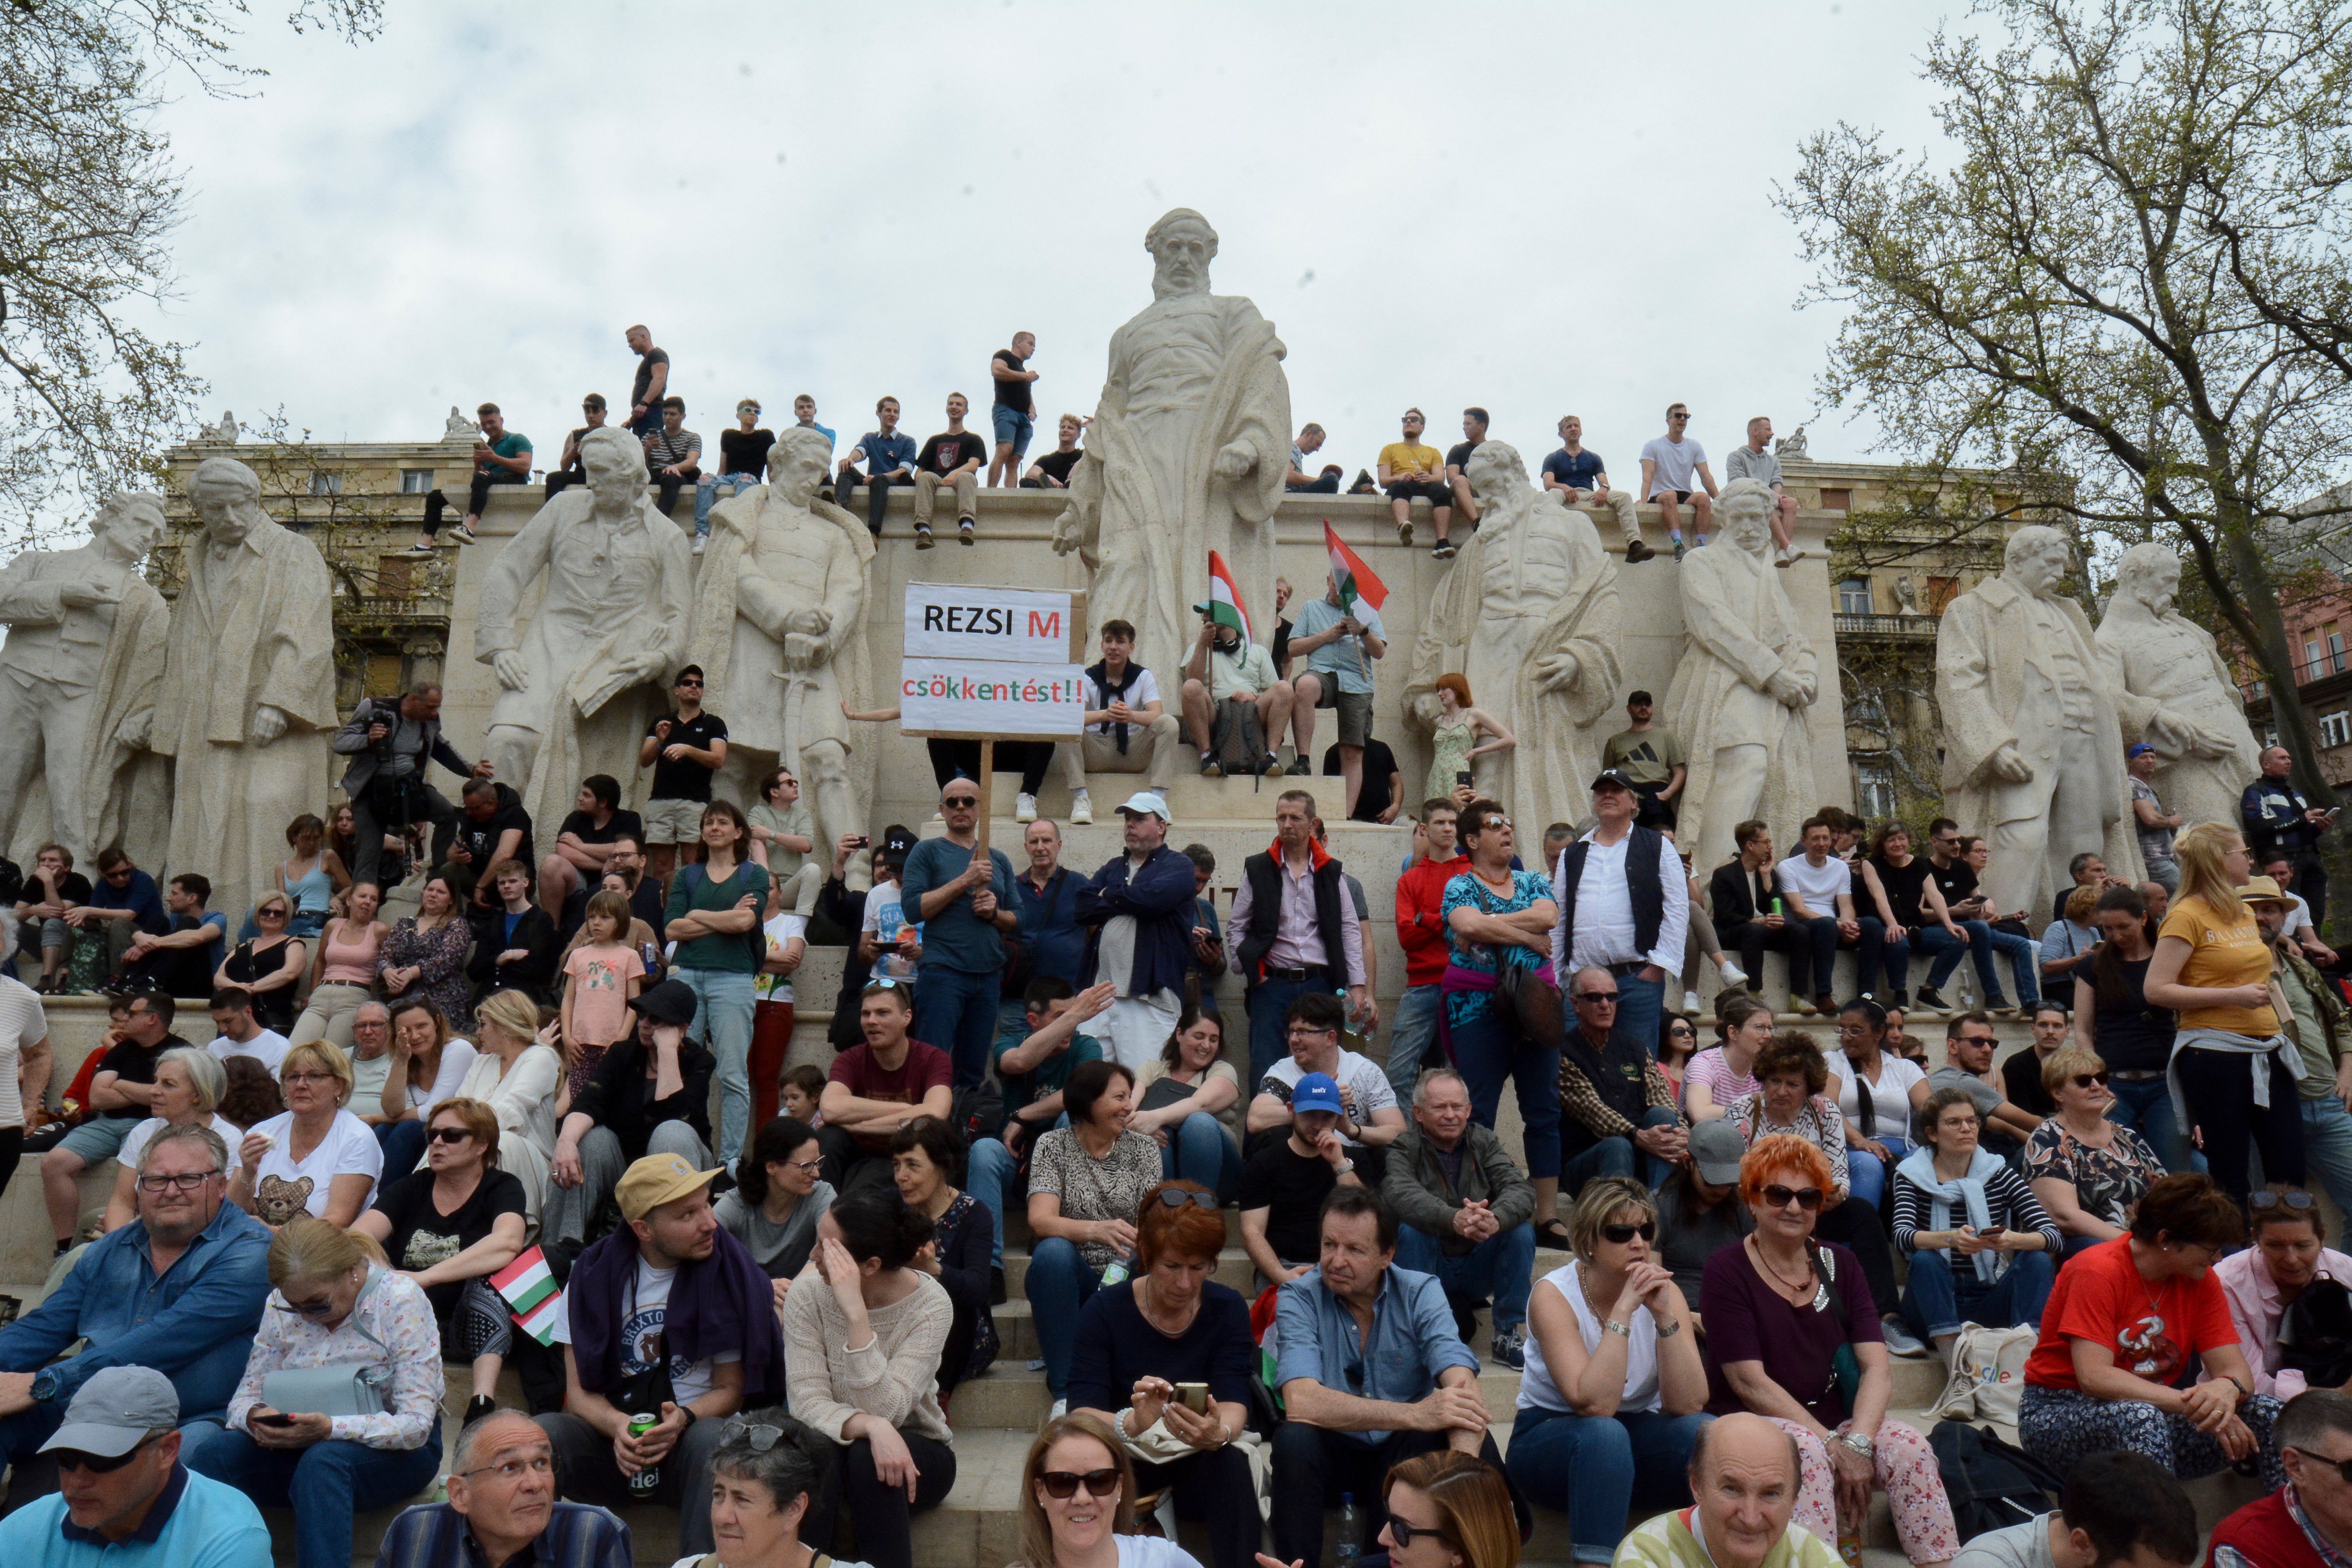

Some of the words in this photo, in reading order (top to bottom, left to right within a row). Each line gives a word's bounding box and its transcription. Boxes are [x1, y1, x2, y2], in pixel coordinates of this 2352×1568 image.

[924, 605, 1013, 635] REZSI
[1028, 611, 1060, 638] M
[903, 674, 1082, 703] csökkentést!!
[621, 1310, 664, 1346] BRIXTO
[630, 1467, 659, 1488] Hei
